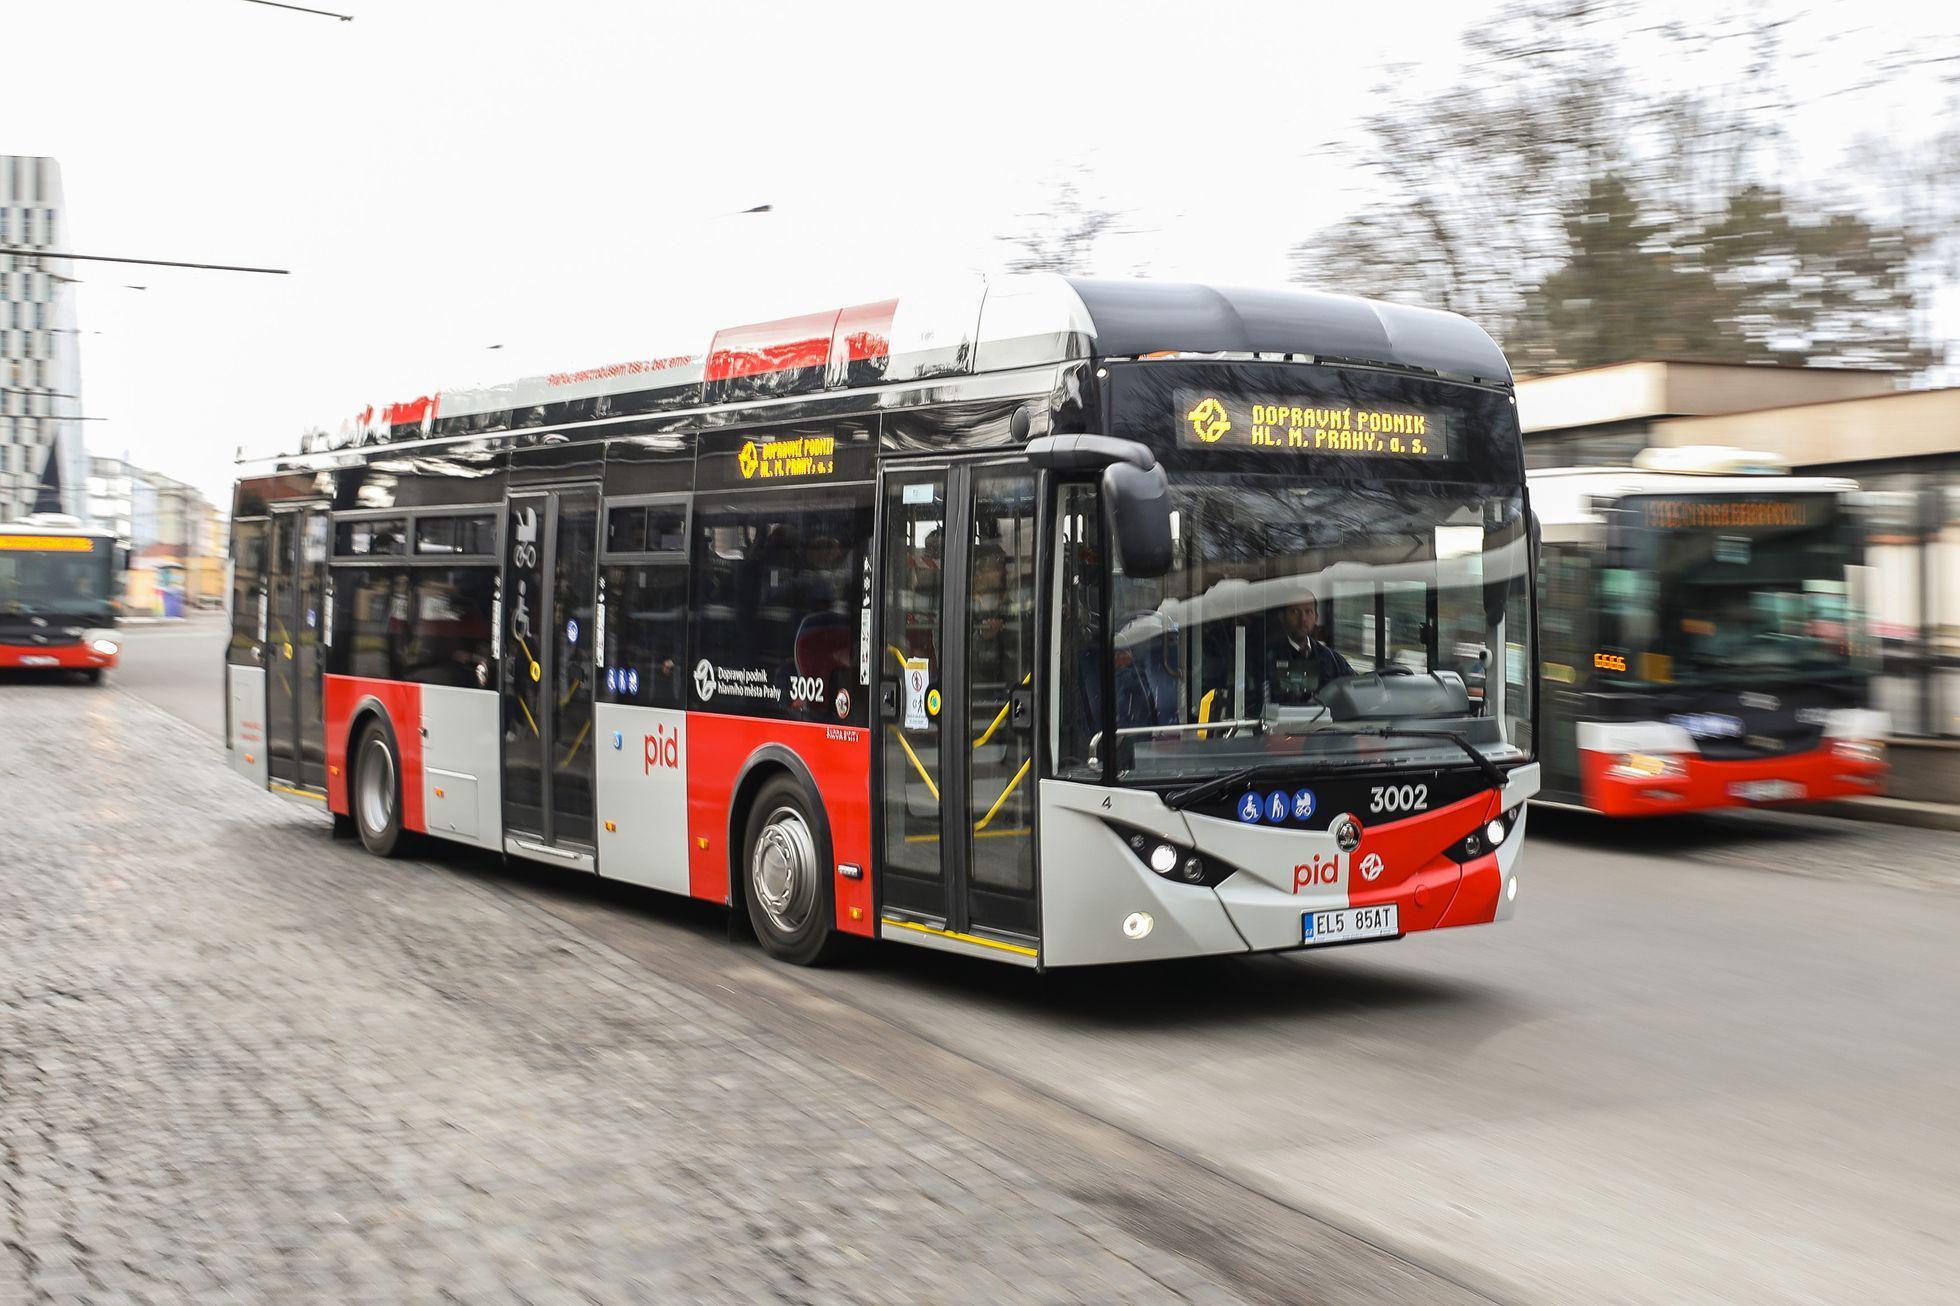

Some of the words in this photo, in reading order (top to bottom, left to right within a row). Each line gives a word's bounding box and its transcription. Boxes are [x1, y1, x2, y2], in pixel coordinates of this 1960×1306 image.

[1252, 404, 1351, 430] DOPRAVNÍ
[1357, 410, 1426, 434] PODNIK
[1251, 425, 1282, 447] HL.
[1288, 427, 1309, 448] M.
[1315, 428, 1384, 452] PRAHY,
[718, 666, 746, 683] Dopravní
[746, 668, 767, 684] podnik
[718, 681, 744, 697] hlavního
[744, 683, 762, 698] města
[763, 685, 781, 701] Prahy
[790, 676, 824, 702] 3002
[645, 723, 678, 776] pid
[1102, 795, 1112, 809] 4
[1370, 784, 1428, 814] 3002
[1293, 854, 1339, 895] pid
[1317, 913, 1344, 935] EL5
[1355, 908, 1390, 930] 85AT
